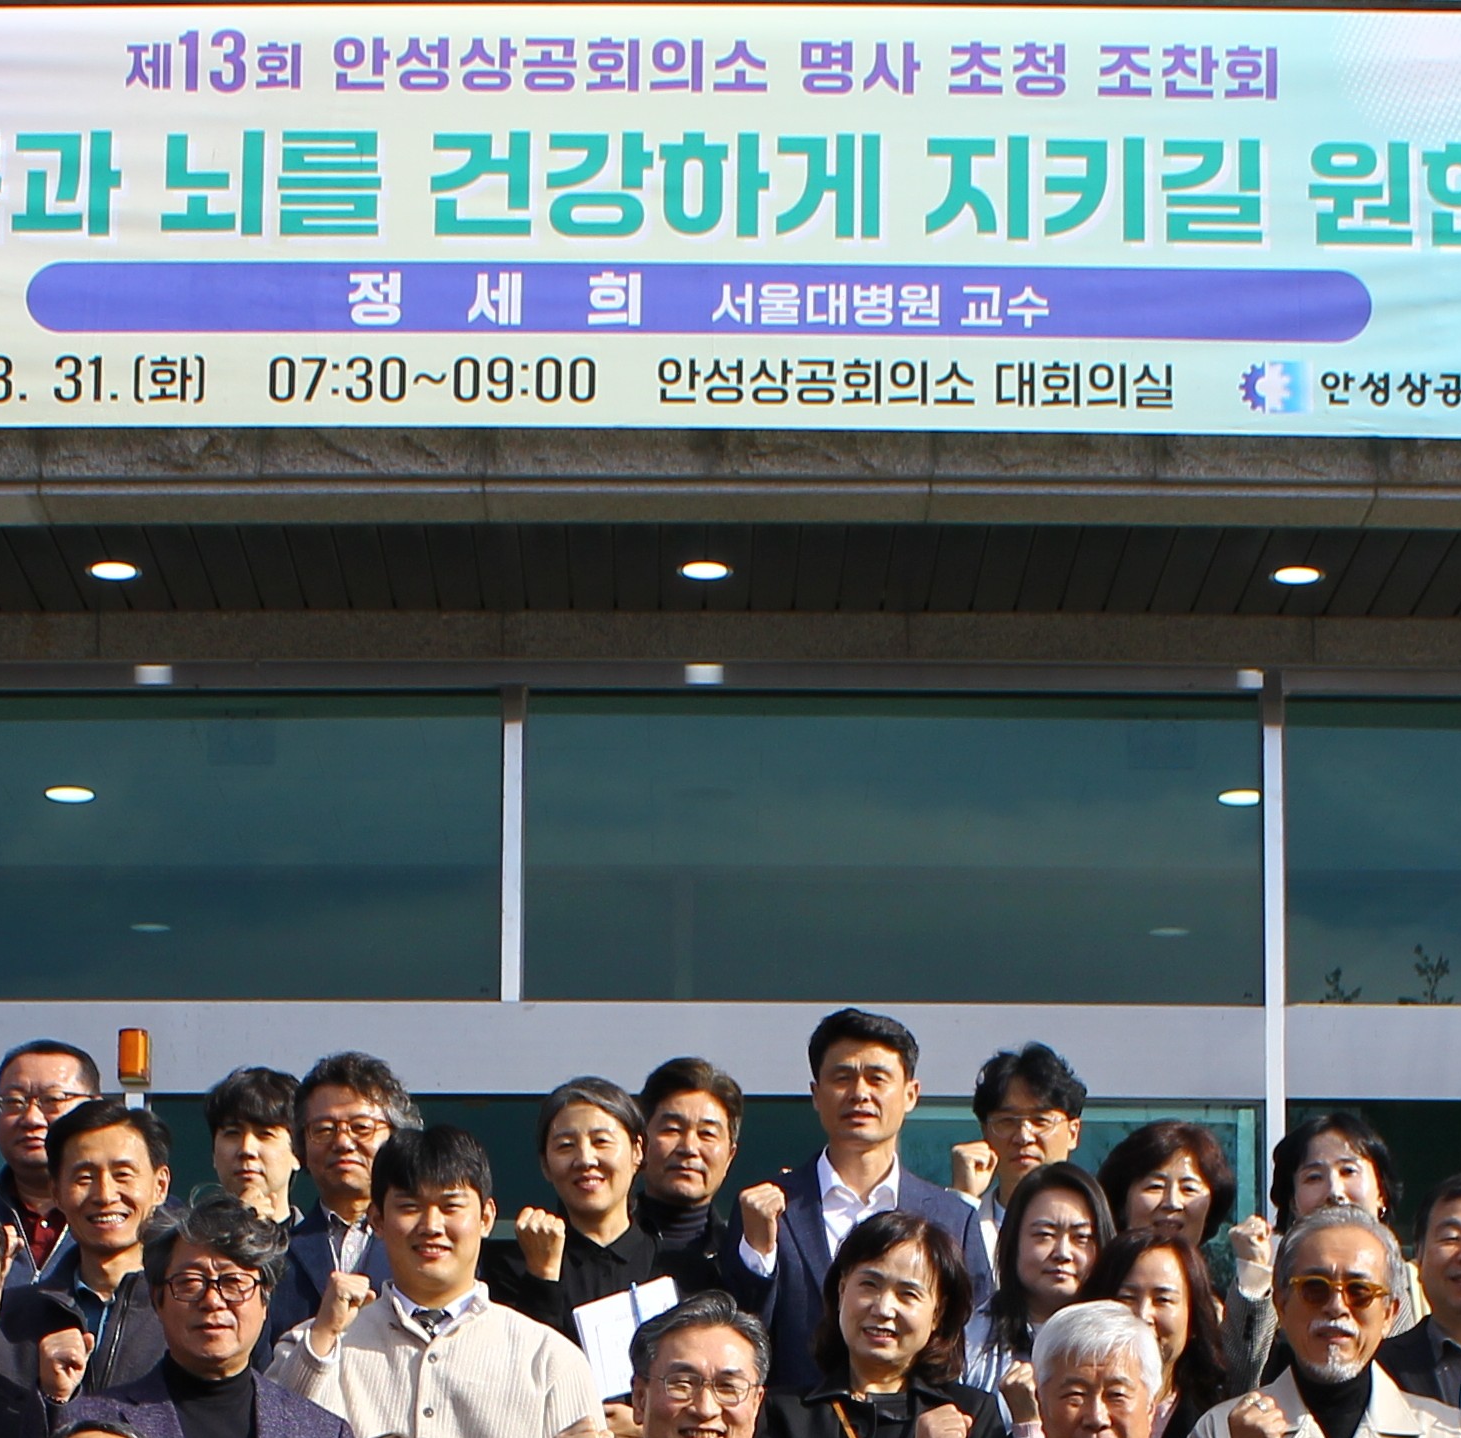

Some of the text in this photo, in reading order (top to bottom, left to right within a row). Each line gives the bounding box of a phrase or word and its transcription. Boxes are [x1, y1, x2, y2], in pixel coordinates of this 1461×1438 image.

[124, 29, 1280, 102] 제13회 안성상공회의소 명사 초청 조찬회
[160, 130, 383, 237] 뇌를
[429, 130, 881, 239] 건강하게
[925, 137, 1265, 244] 지키길
[710, 282, 942, 326] 서울대병원
[959, 285, 1051, 328] 교수
[268, 356, 598, 403] 07:30~09:00
[657, 359, 976, 407] 안성상공회의소
[995, 362, 1175, 409] 대회의실
